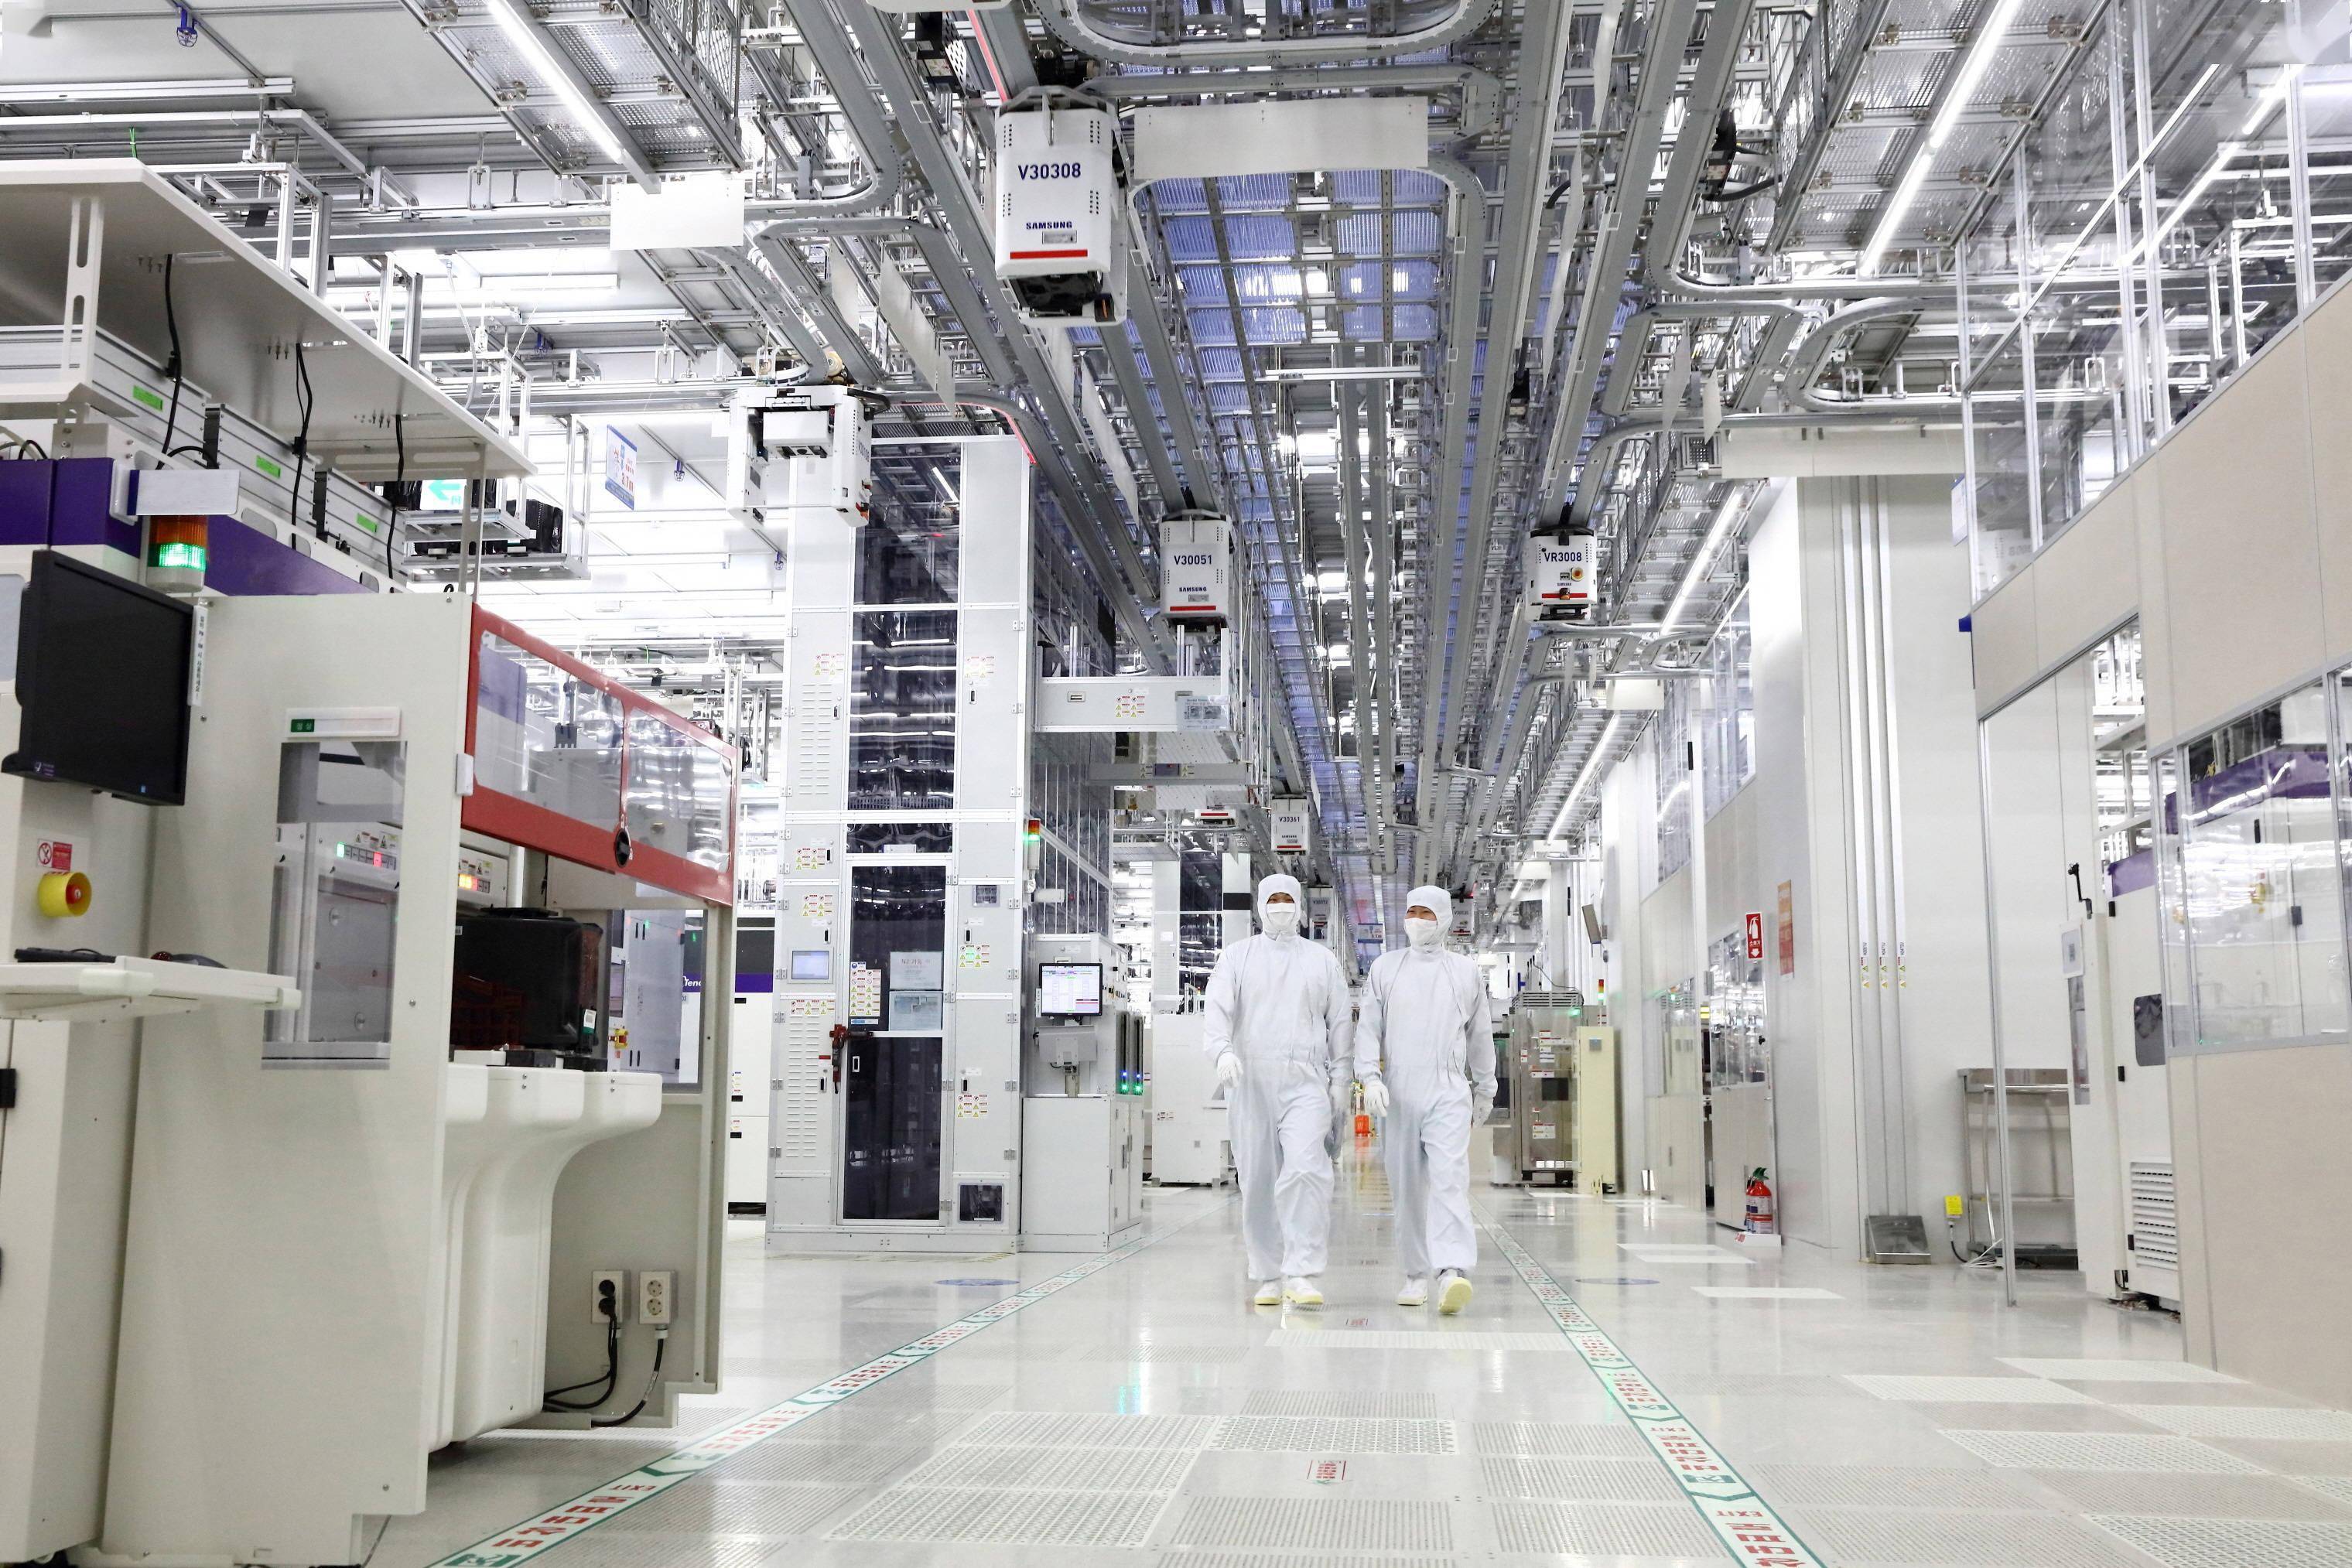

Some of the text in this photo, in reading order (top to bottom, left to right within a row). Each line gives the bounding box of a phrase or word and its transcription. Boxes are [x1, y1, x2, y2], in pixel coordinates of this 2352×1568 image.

[1017, 162, 1082, 180] V30308
[1025, 220, 1072, 230] SAMSUNG
[1174, 555, 1212, 565] V30051
[1544, 552, 1582, 562] VR3008
[608, 1484, 657, 1492] EXIT
